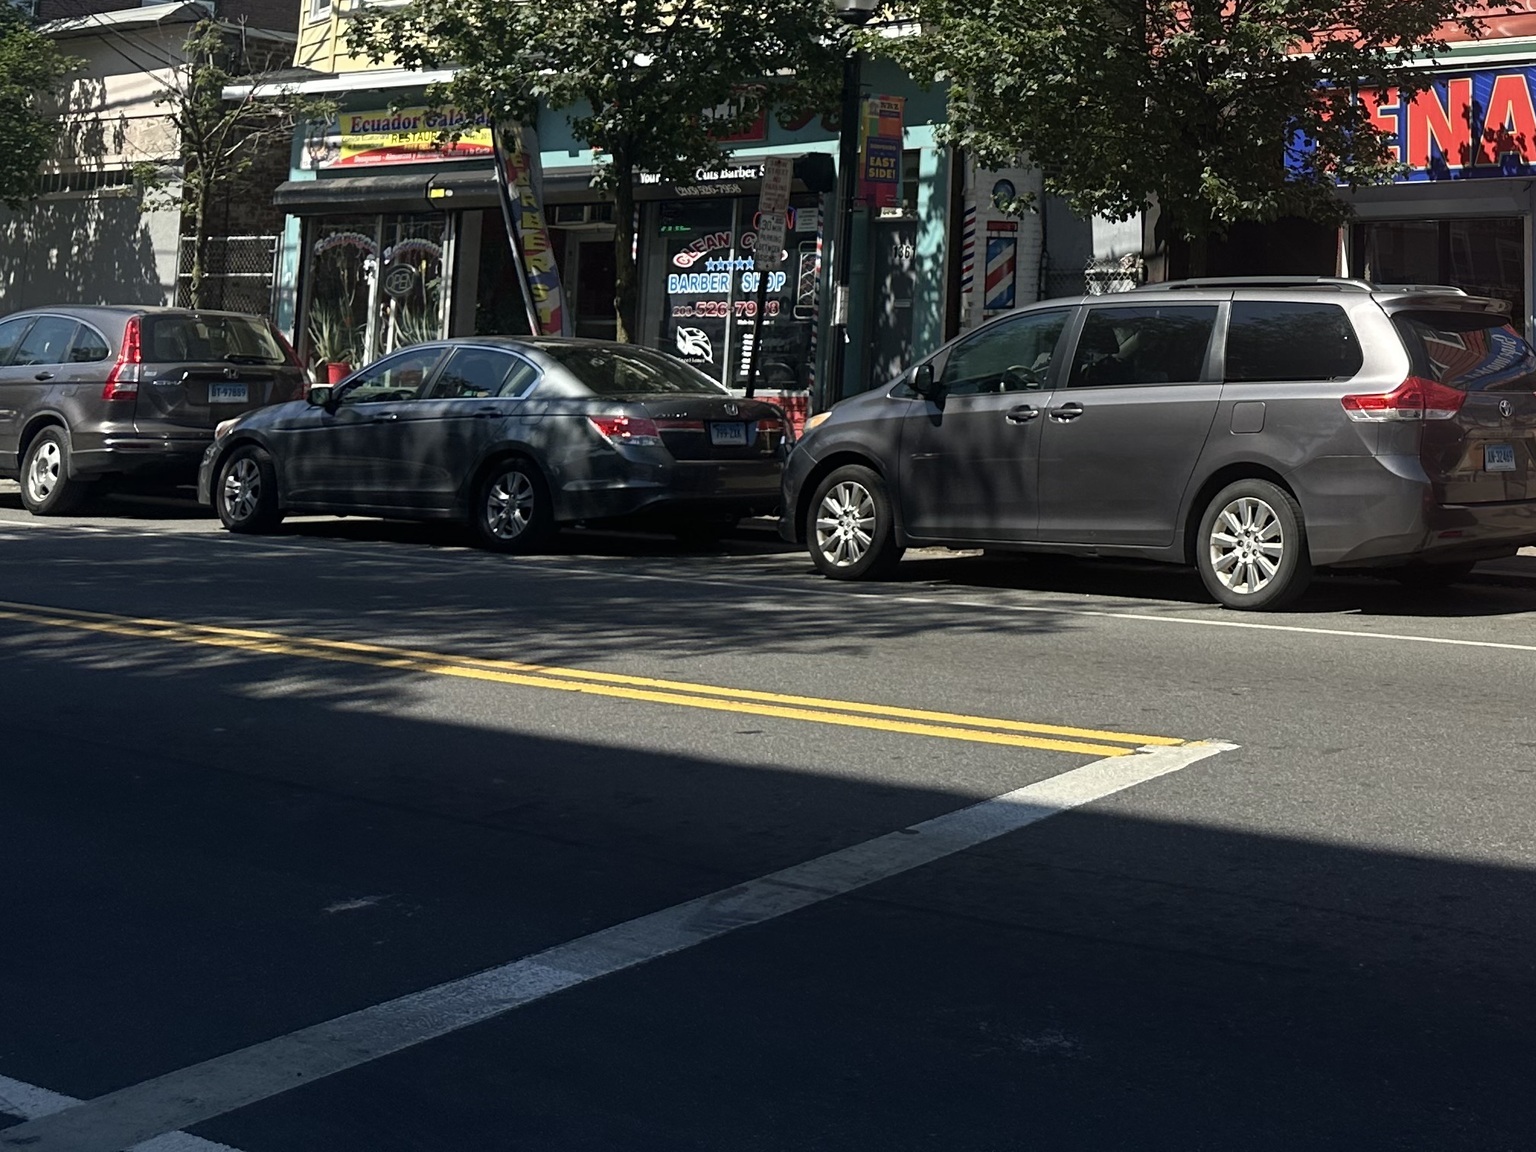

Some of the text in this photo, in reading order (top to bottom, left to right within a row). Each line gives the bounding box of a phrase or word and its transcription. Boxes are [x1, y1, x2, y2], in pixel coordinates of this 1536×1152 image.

[351, 114, 421, 133] Ecuador
[391, 130, 439, 145] RESTAUR
[870, 157, 896, 168] EAST
[868, 168, 896, 179] SIDE!
[673, 232, 732, 268] CLEAN
[668, 272, 730, 294] BARBER
[672, 300, 780, 318] 203-526-798
